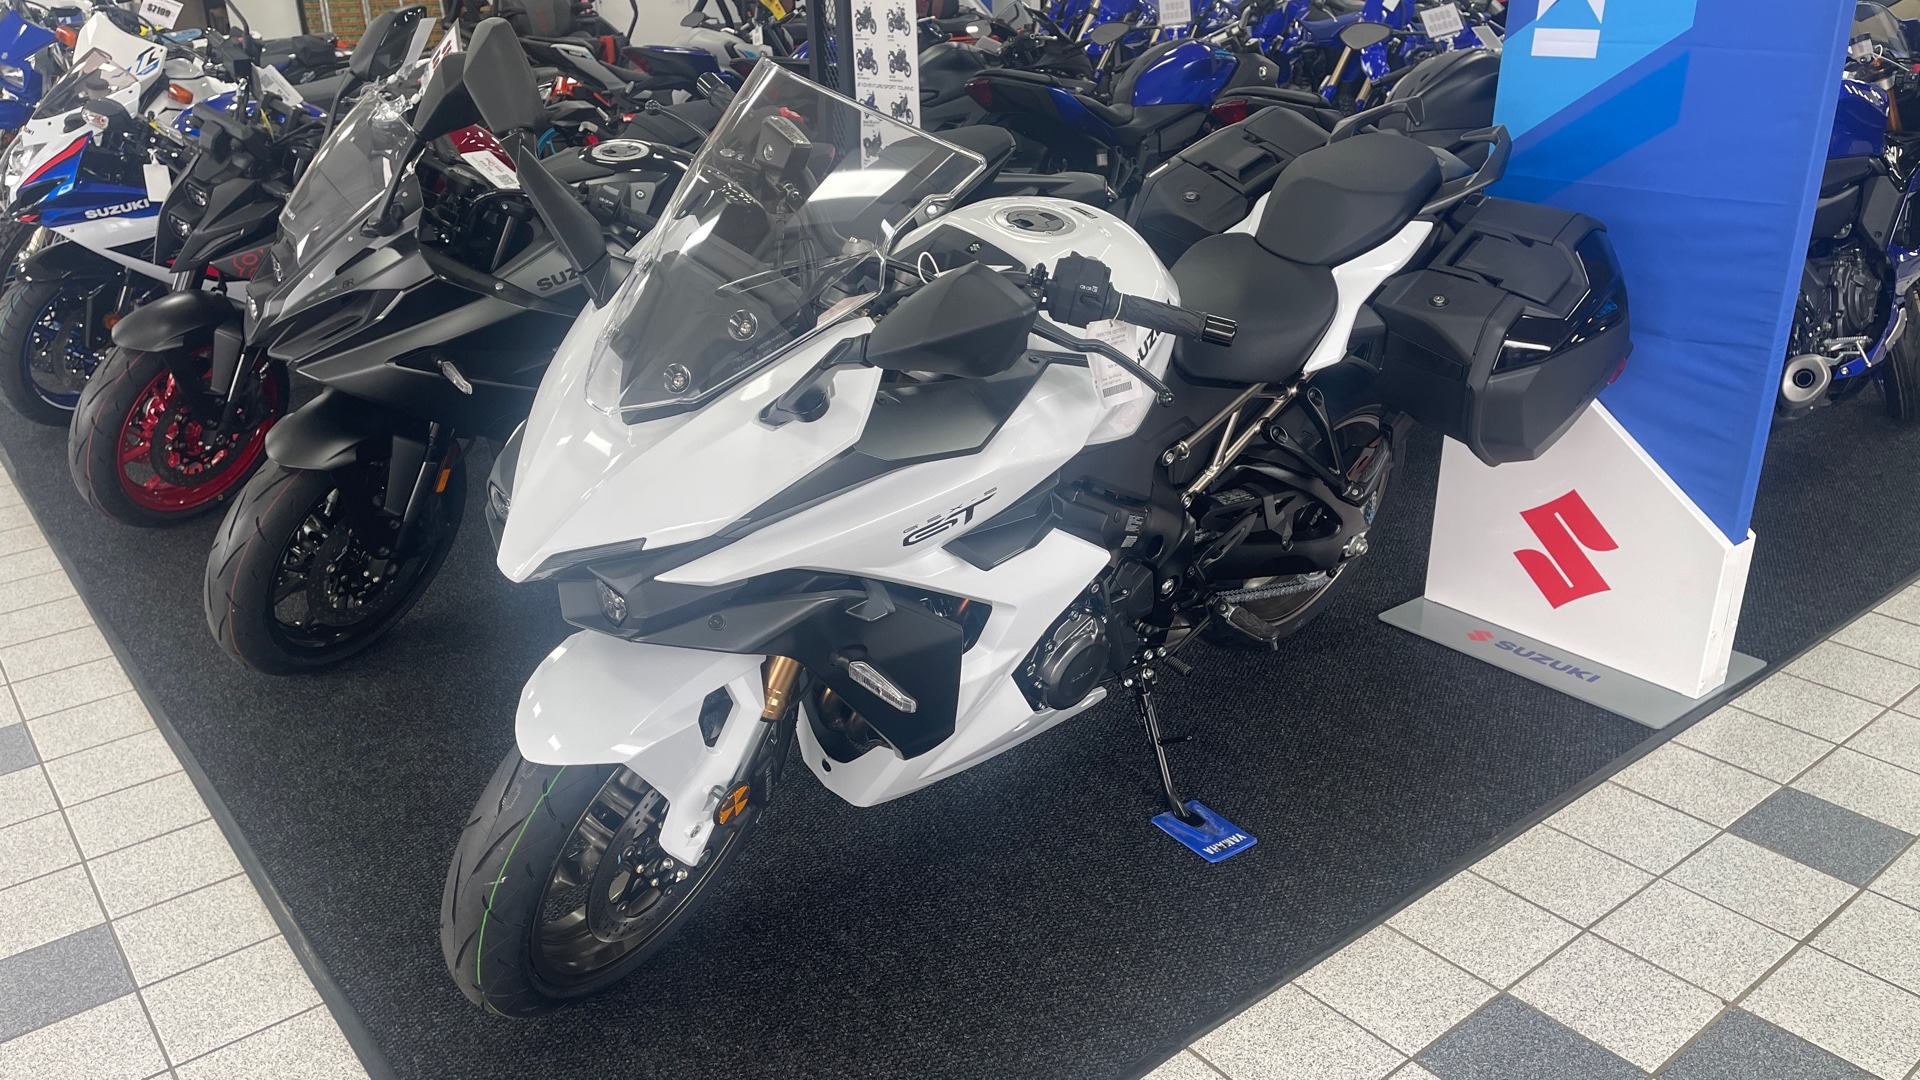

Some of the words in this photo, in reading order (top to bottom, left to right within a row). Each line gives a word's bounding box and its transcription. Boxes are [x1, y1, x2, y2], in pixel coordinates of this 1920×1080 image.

[84, 198, 151, 219] SUZUKI
[1137, 329, 1161, 366] UZ
[902, 492, 998, 547] GT
[1494, 640, 1602, 683] SUZUKI
[1202, 833, 1248, 855] YAMAHA
